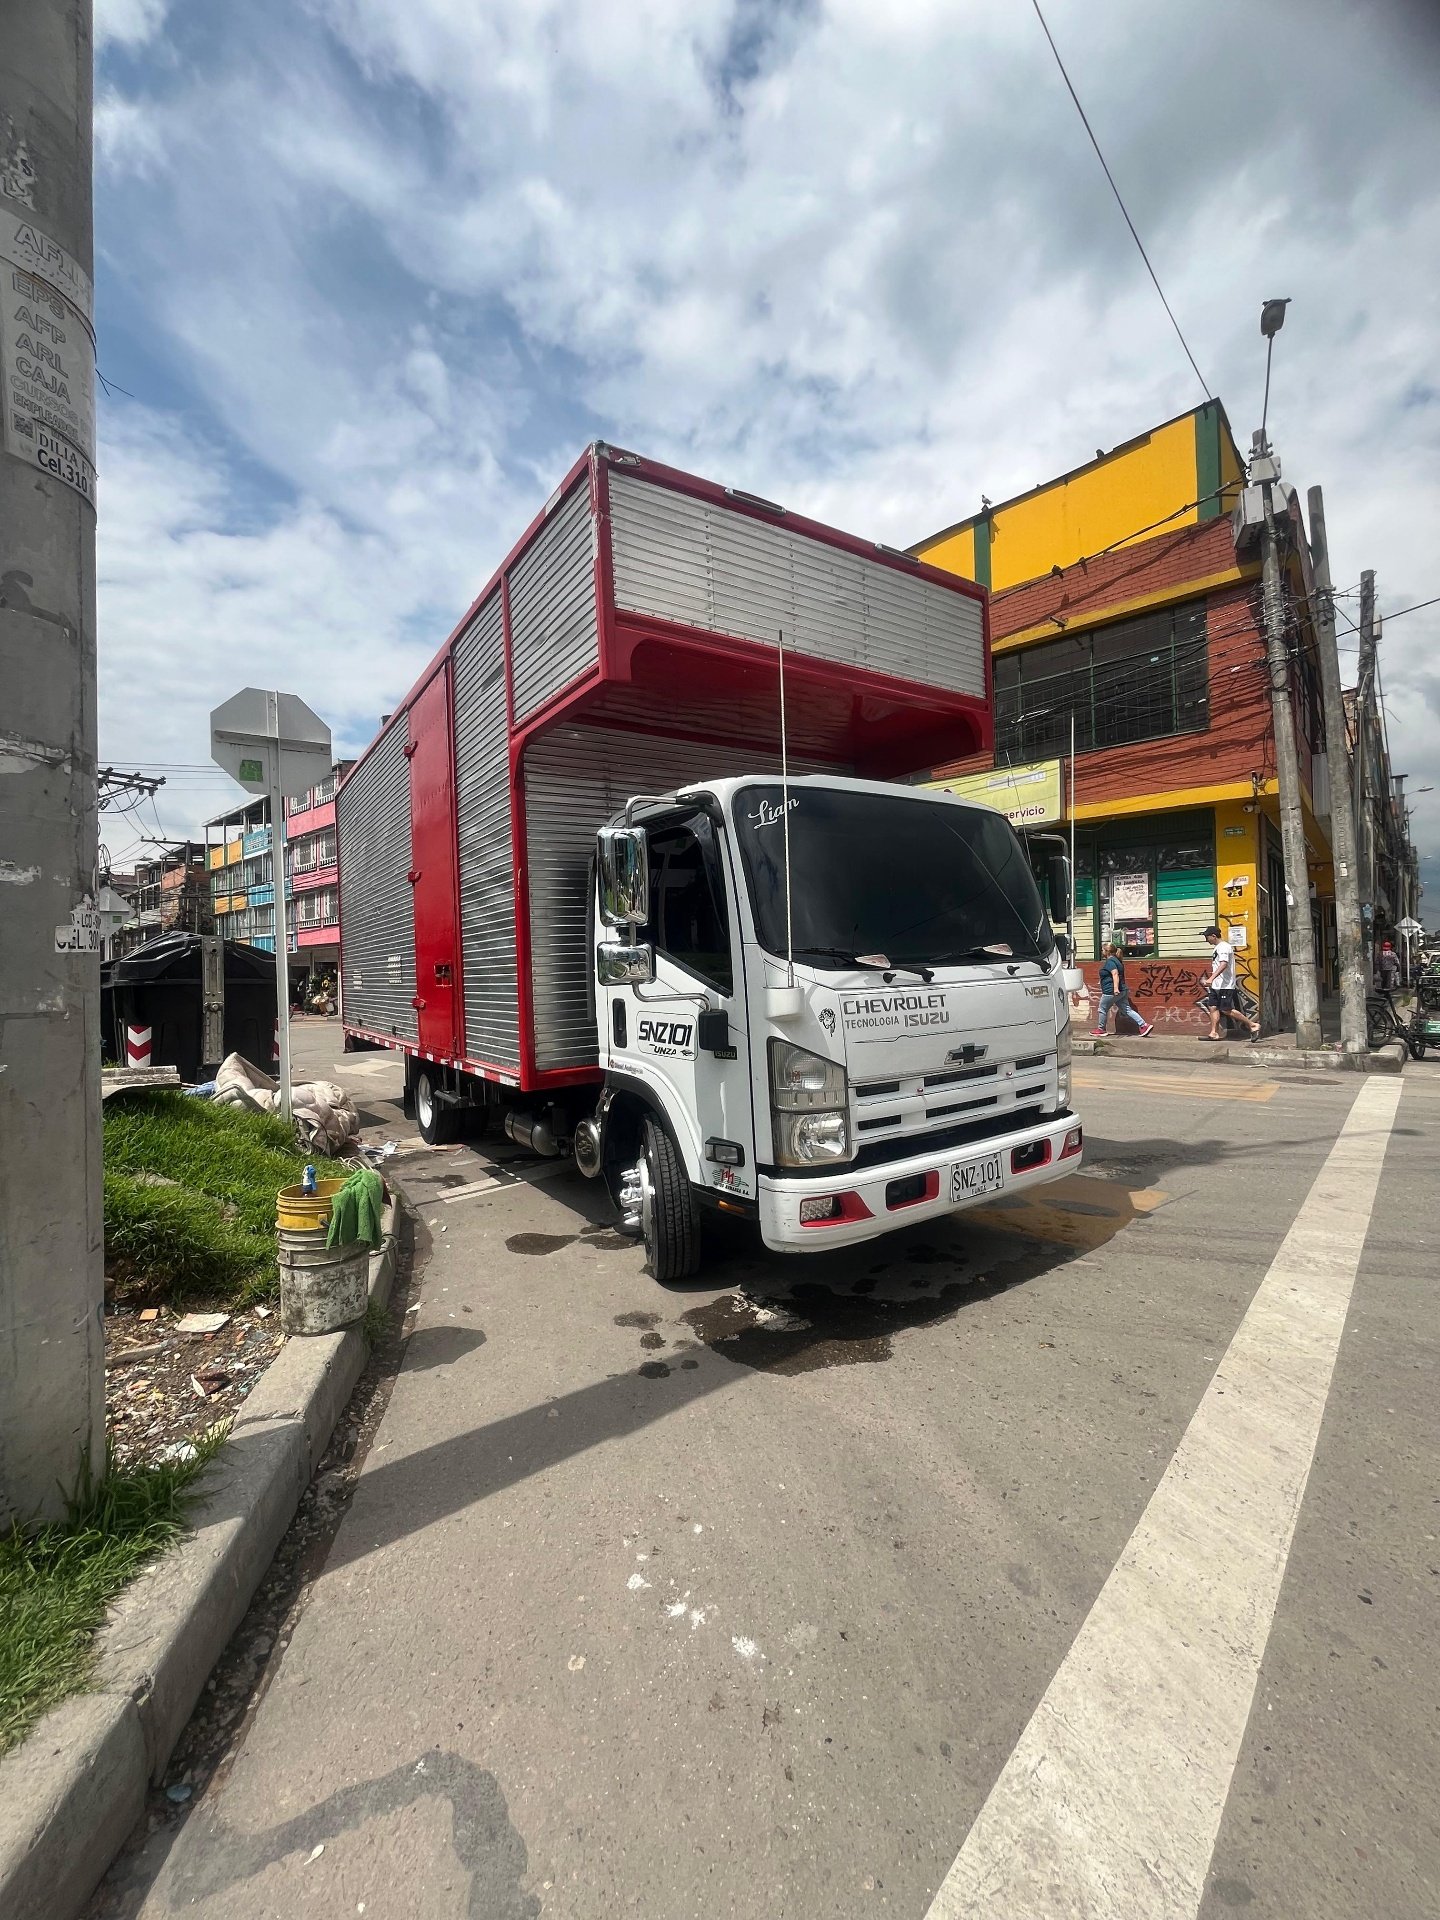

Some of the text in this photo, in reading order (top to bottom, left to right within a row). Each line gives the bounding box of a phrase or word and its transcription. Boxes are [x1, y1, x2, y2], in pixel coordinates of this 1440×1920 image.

[12, 271, 65, 319] EPS
[14, 305, 67, 345] AFP
[15, 333, 69, 379] ARL
[15, 356, 71, 405] CAJA
[39, 432, 78, 468] DILIA
[1003, 805, 1045, 819] servicio
[843, 994, 947, 1015] CHEVROLET
[845, 1010, 950, 1030] TECNOLOGIA ISUZU
[639, 1020, 693, 1047] SNZ101
